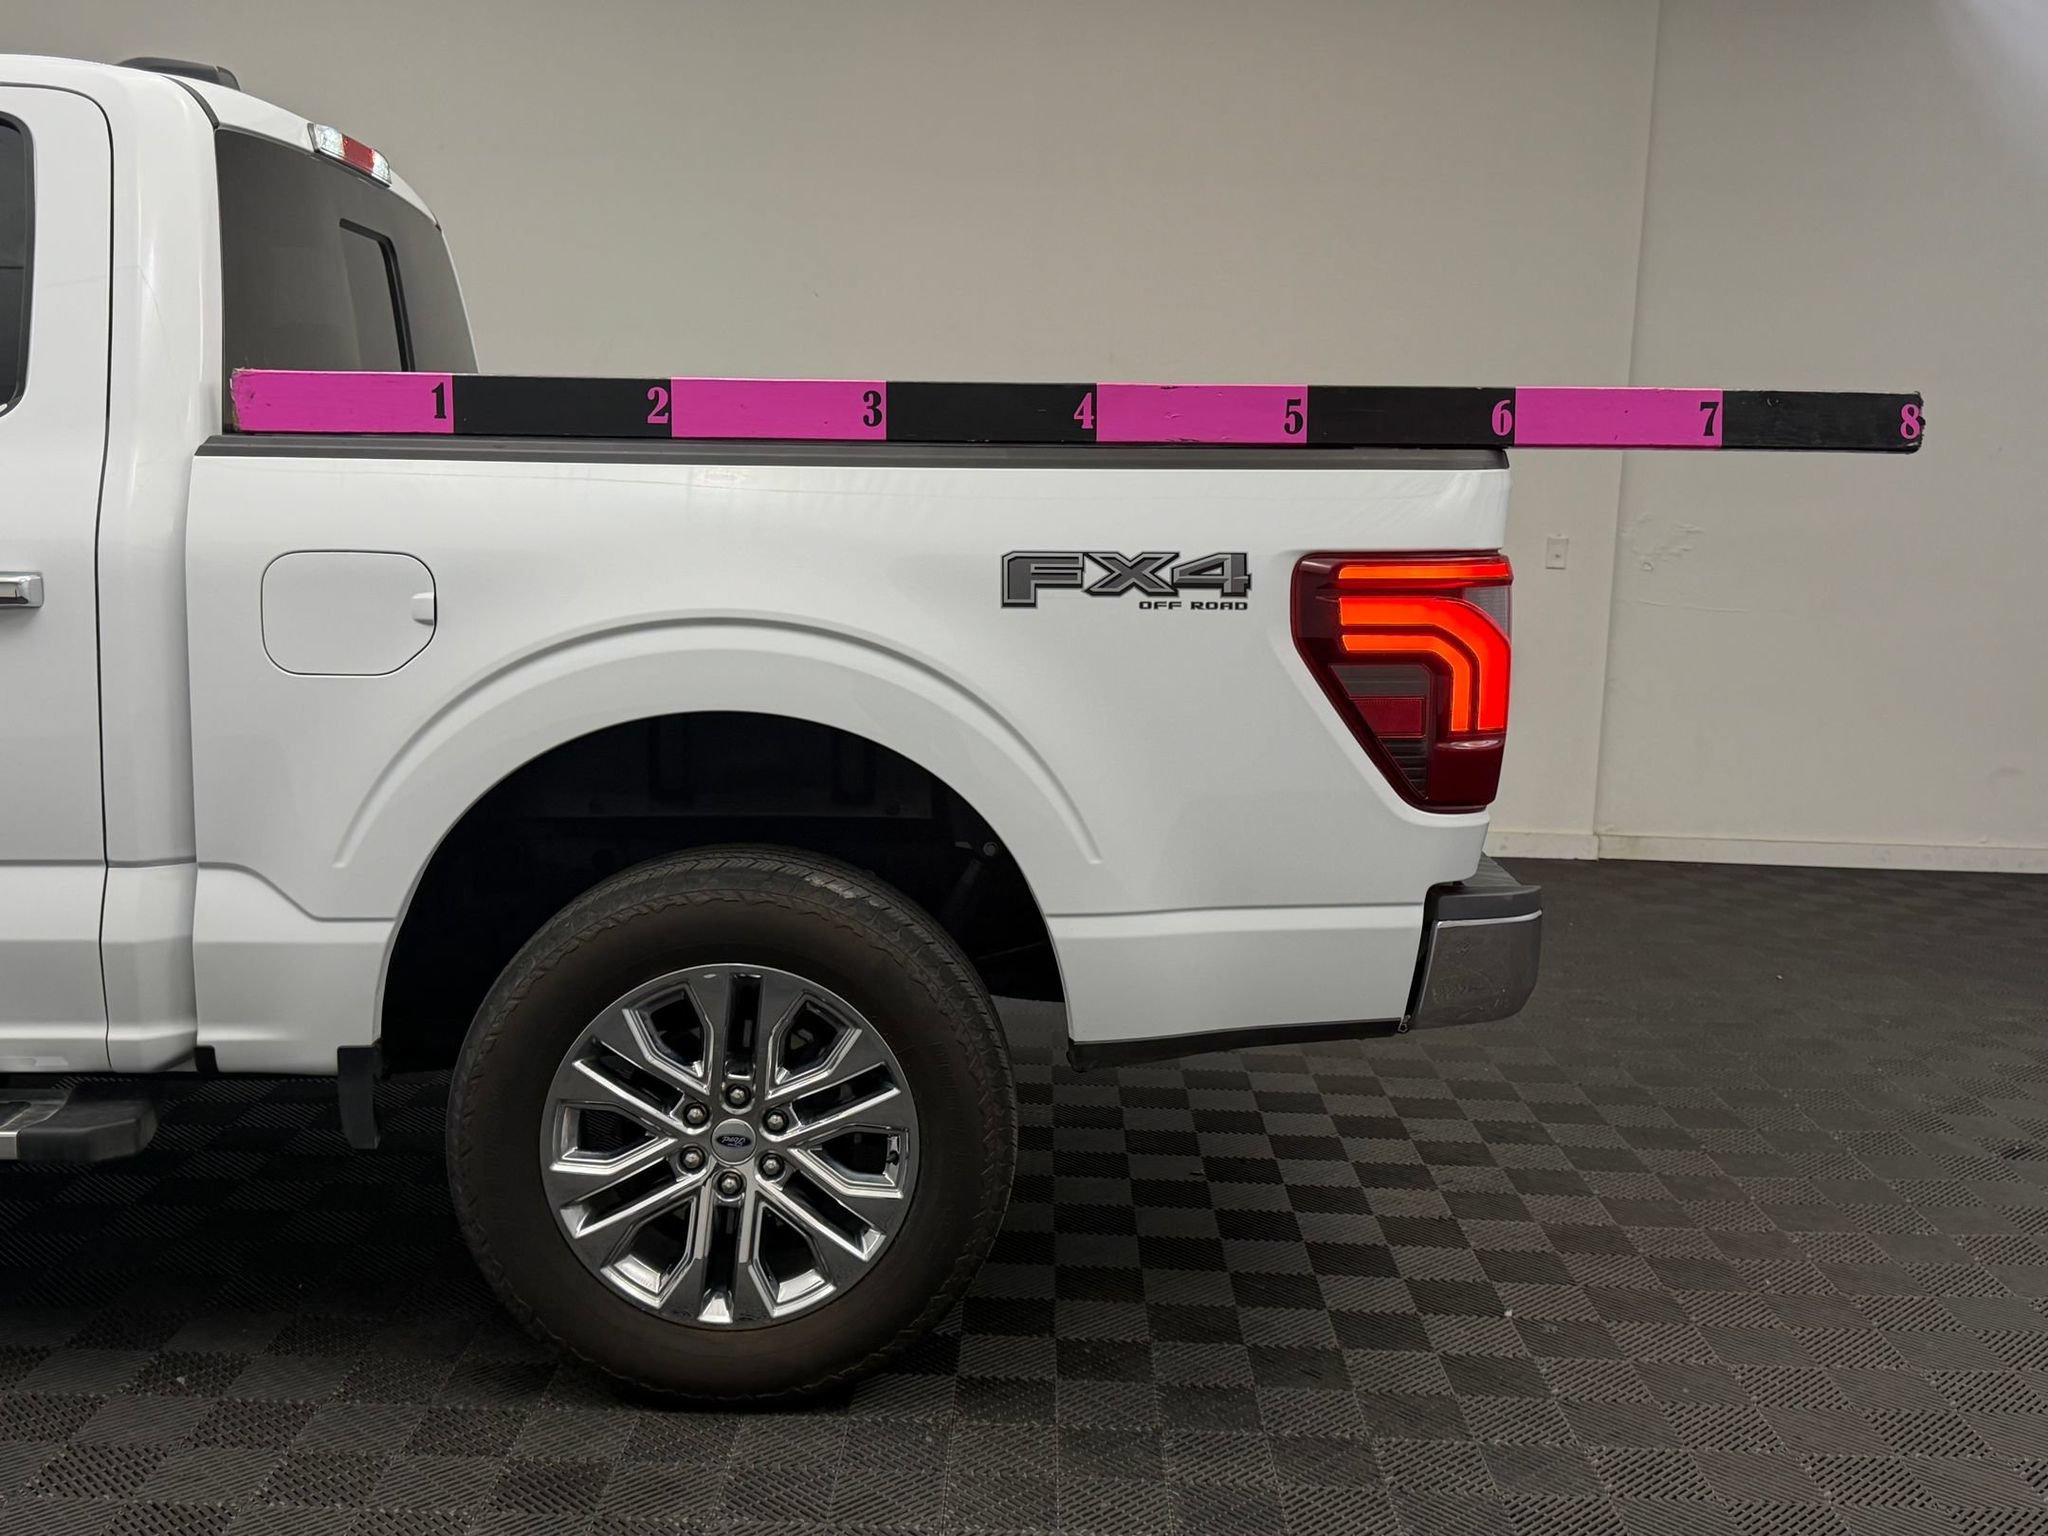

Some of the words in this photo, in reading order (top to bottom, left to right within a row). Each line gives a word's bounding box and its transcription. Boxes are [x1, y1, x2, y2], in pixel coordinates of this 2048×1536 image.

[431, 382, 448, 420] 1
[646, 387, 670, 425] 2
[862, 391, 884, 427] 3
[1074, 392, 1095, 430] 4
[1283, 398, 1305, 435] 5
[1491, 398, 1513, 436] 6
[1699, 401, 1720, 438] 7
[1899, 404, 1922, 440] 8
[1000, 551, 1252, 609] FX4
[1138, 600, 1184, 611] OFF
[1189, 600, 1249, 611] ROAD
[721, 1136, 747, 1148] Ford
